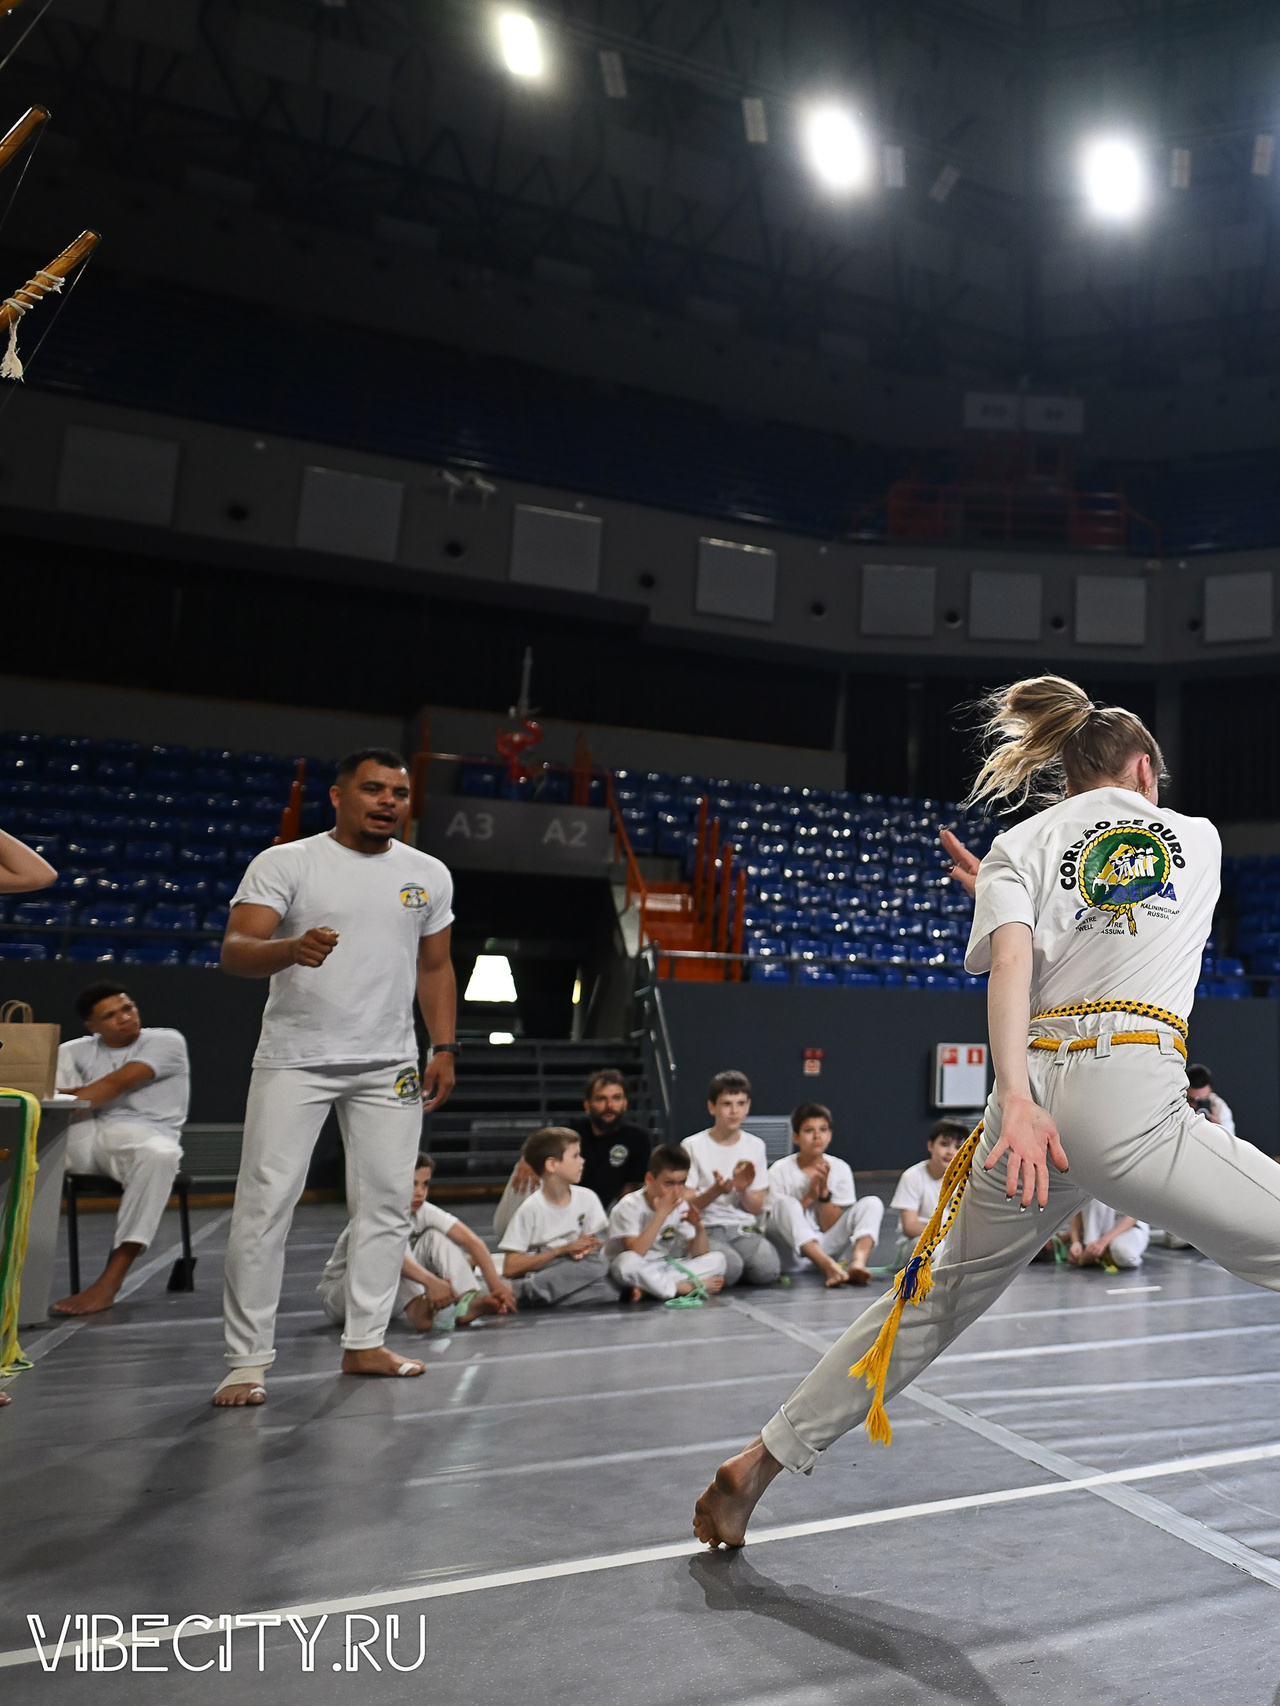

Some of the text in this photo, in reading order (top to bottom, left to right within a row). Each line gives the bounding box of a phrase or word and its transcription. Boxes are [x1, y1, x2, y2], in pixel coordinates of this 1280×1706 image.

[447, 810, 588, 847] A3 A2
[1148, 822, 1186, 869] OURO
[1147, 910, 1170, 920] RUSSIA
